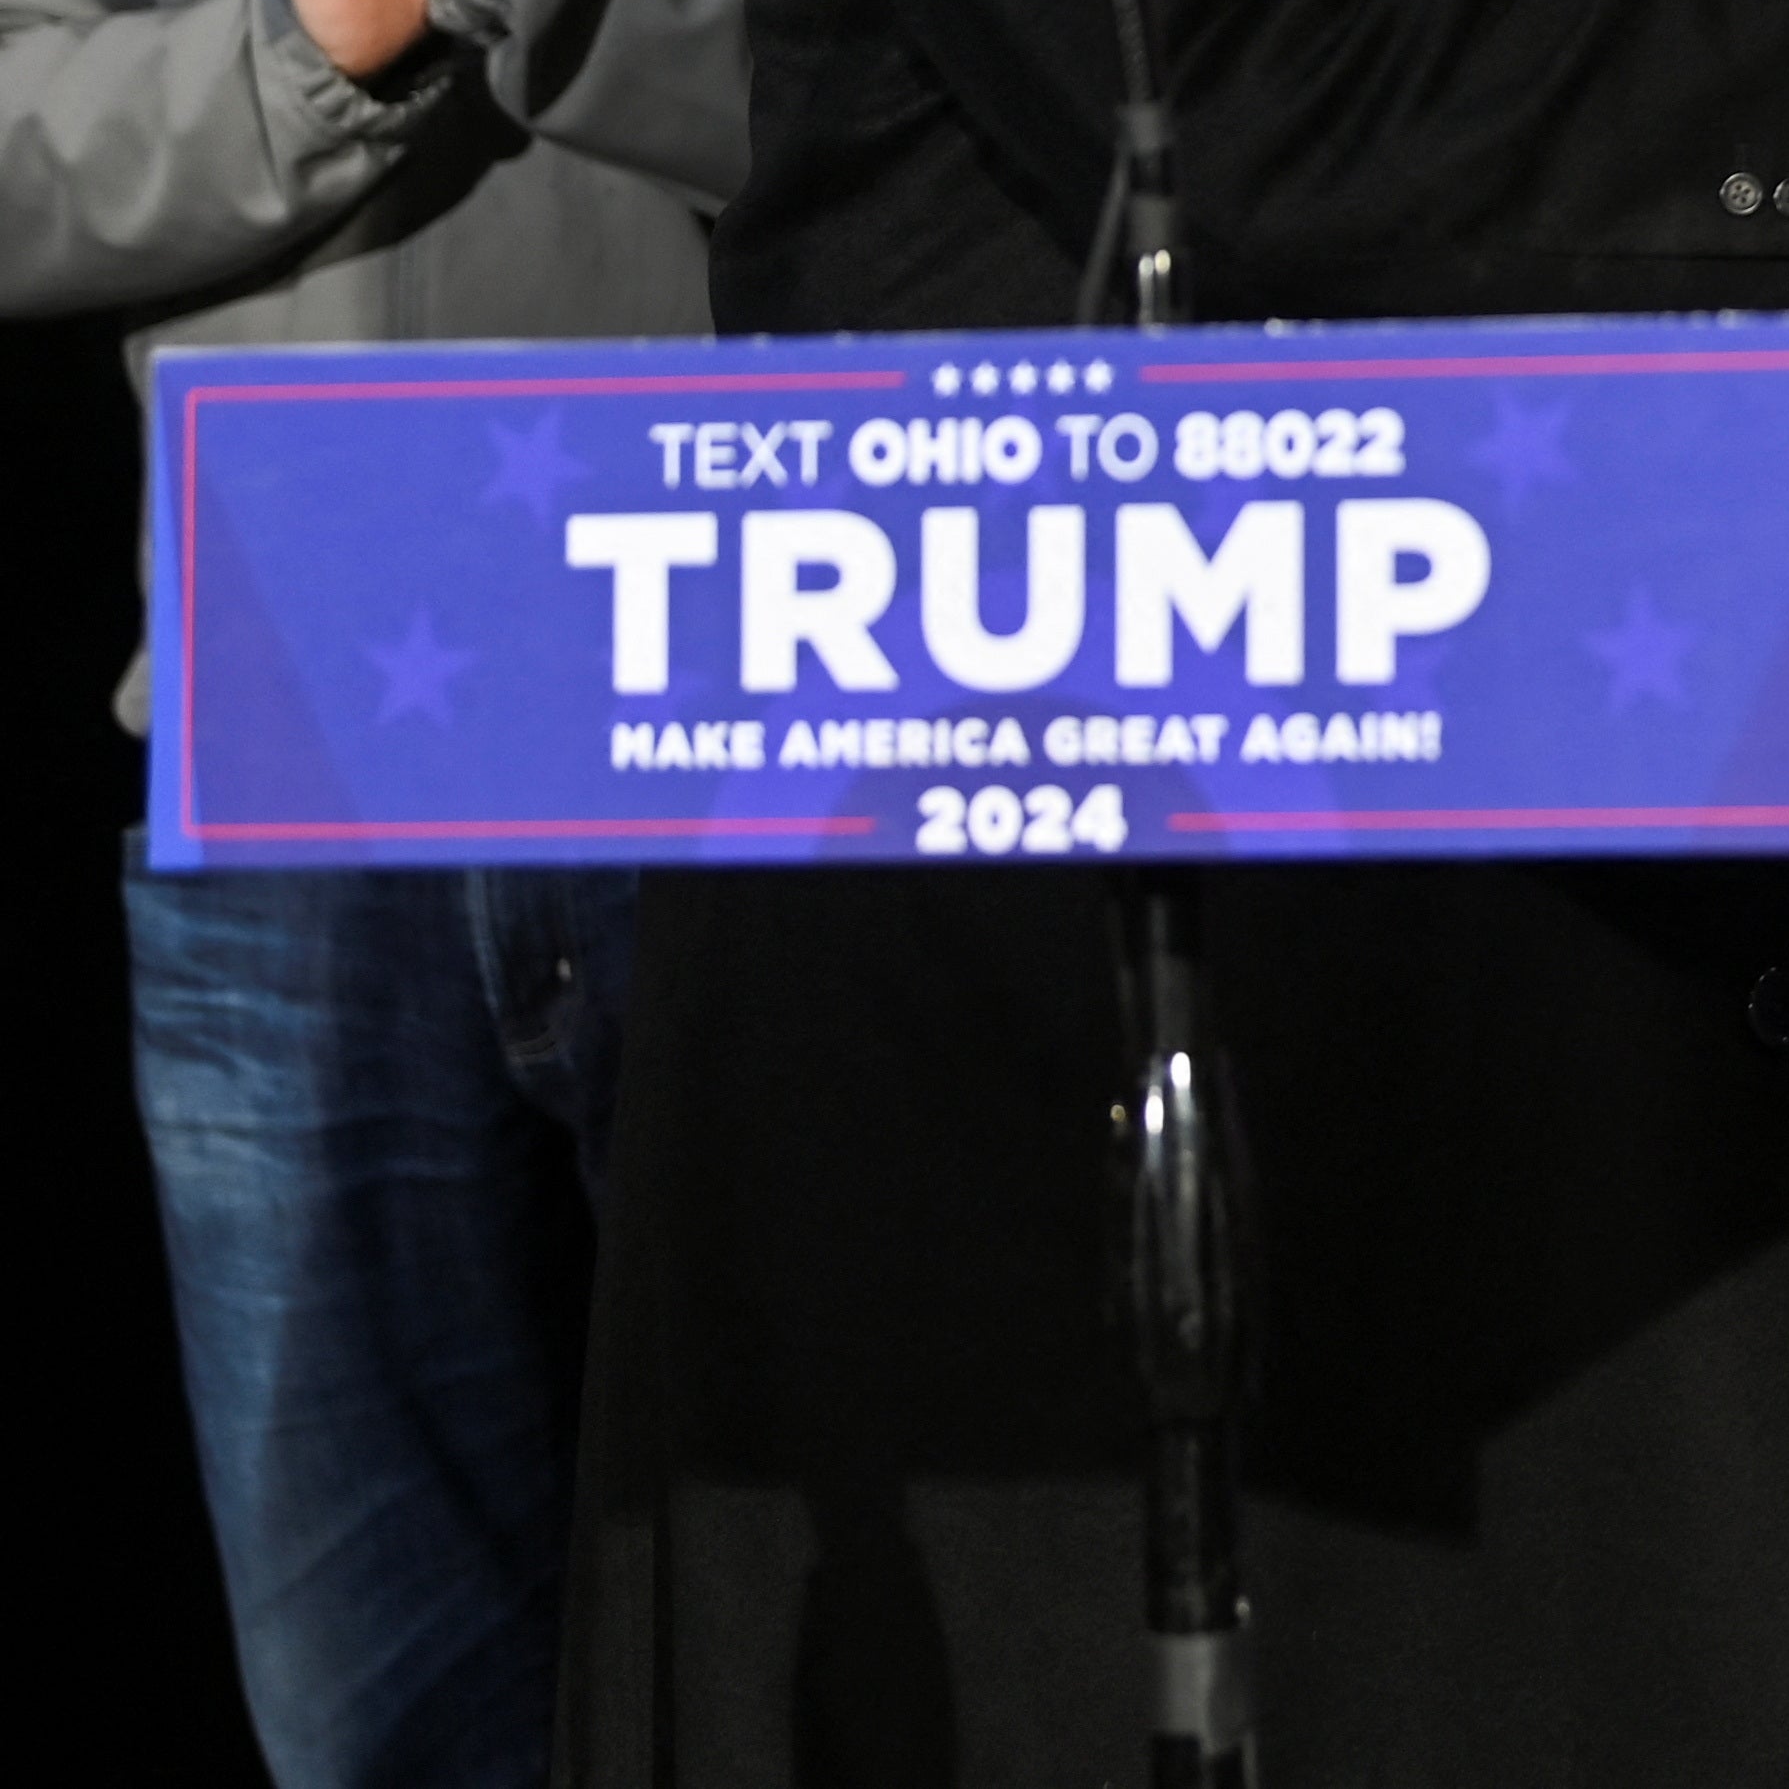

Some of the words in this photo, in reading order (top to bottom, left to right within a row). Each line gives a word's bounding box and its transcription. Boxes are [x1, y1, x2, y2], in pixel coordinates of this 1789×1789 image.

[649, 420, 833, 489] TEXT
[848, 415, 1043, 486] OHIO
[1057, 412, 1160, 483] TO
[1173, 407, 1406, 481] 88022
[565, 497, 1493, 695] TRUMP
[609, 721, 765, 772] MAKE
[777, 717, 1030, 769] AMERICA
[1042, 713, 1229, 767] GREAT
[1240, 710, 1443, 763] AGAIN!
[915, 783, 1129, 856] 2024
